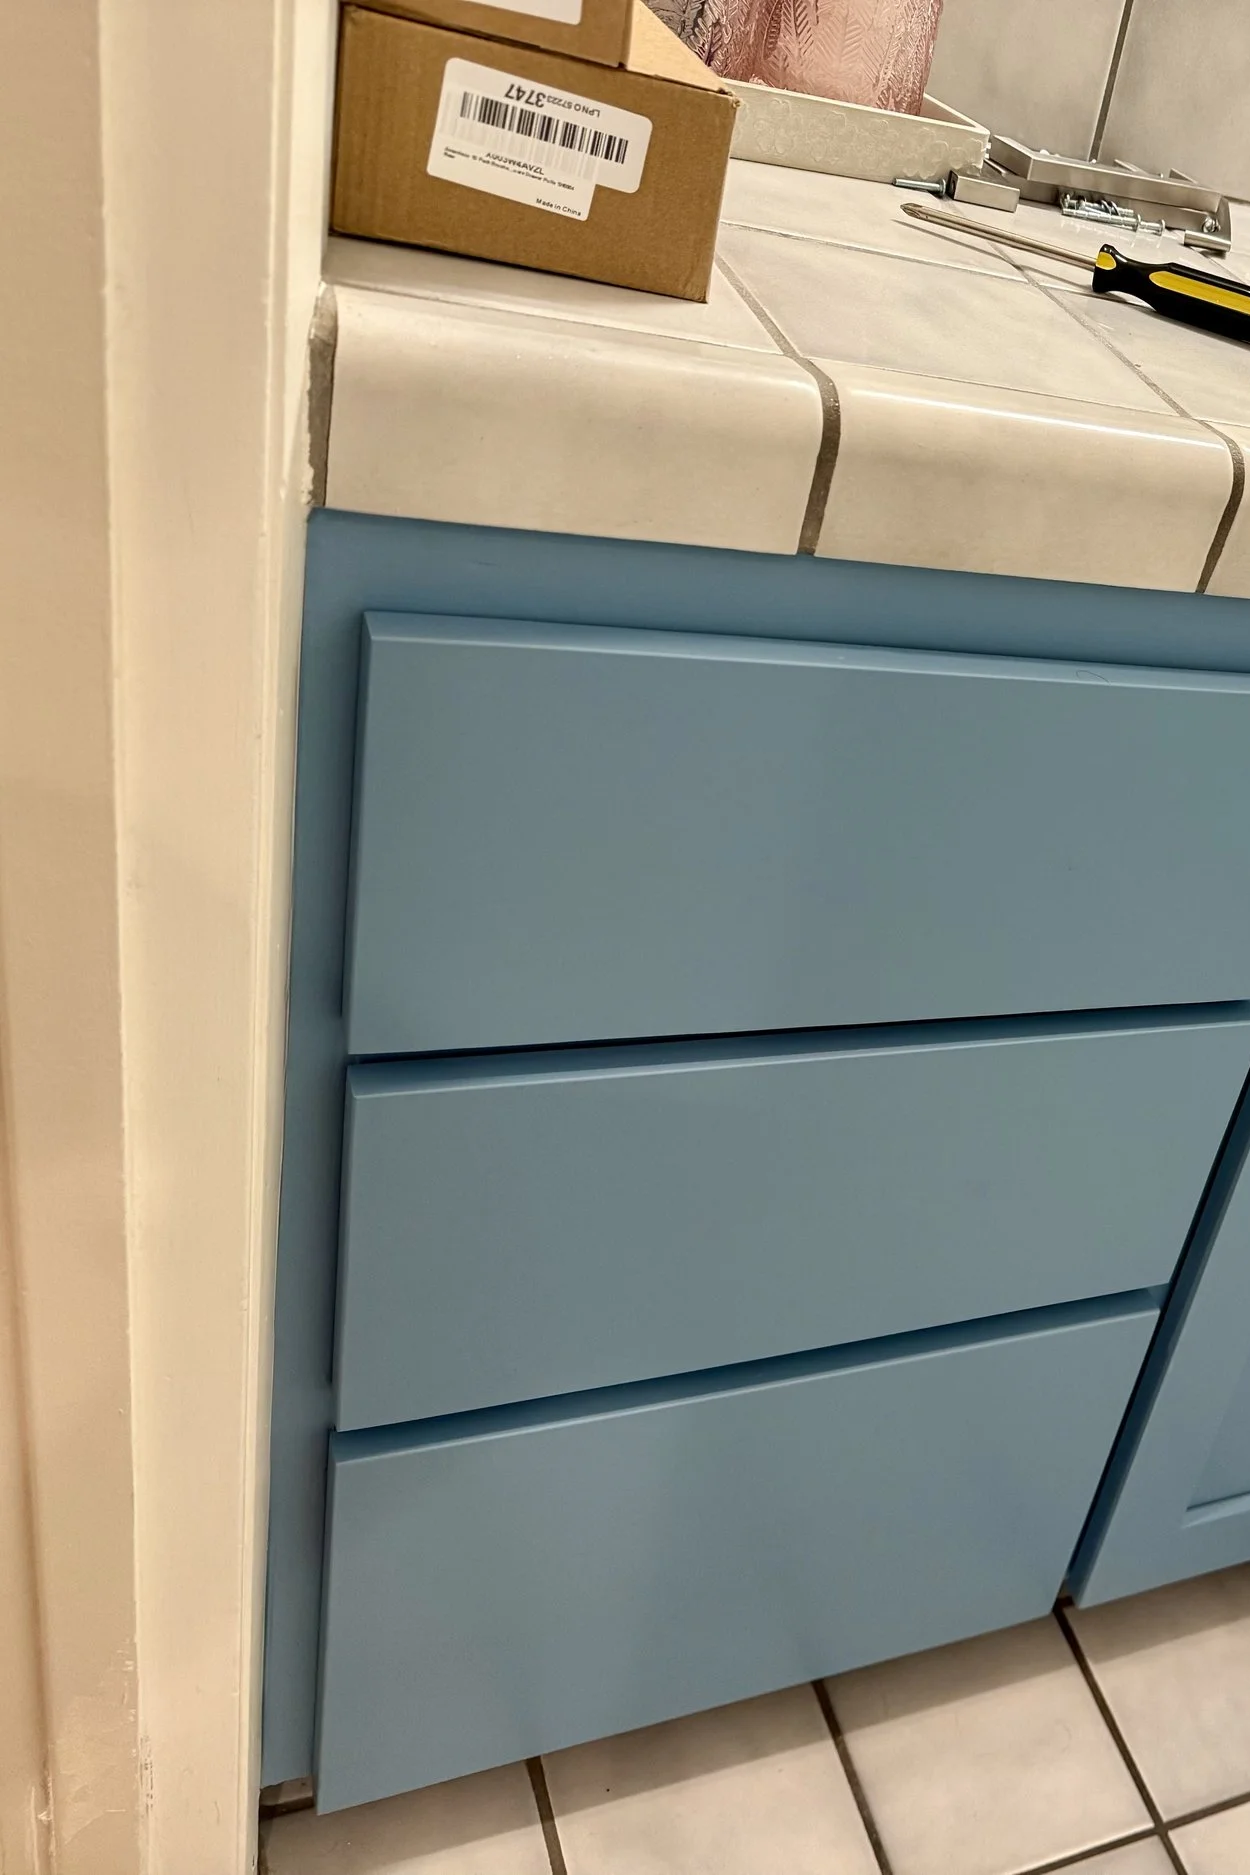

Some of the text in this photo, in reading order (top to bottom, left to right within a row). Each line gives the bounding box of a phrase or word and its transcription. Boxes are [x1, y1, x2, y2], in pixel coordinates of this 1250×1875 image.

[536, 198, 581, 217] Made in China
